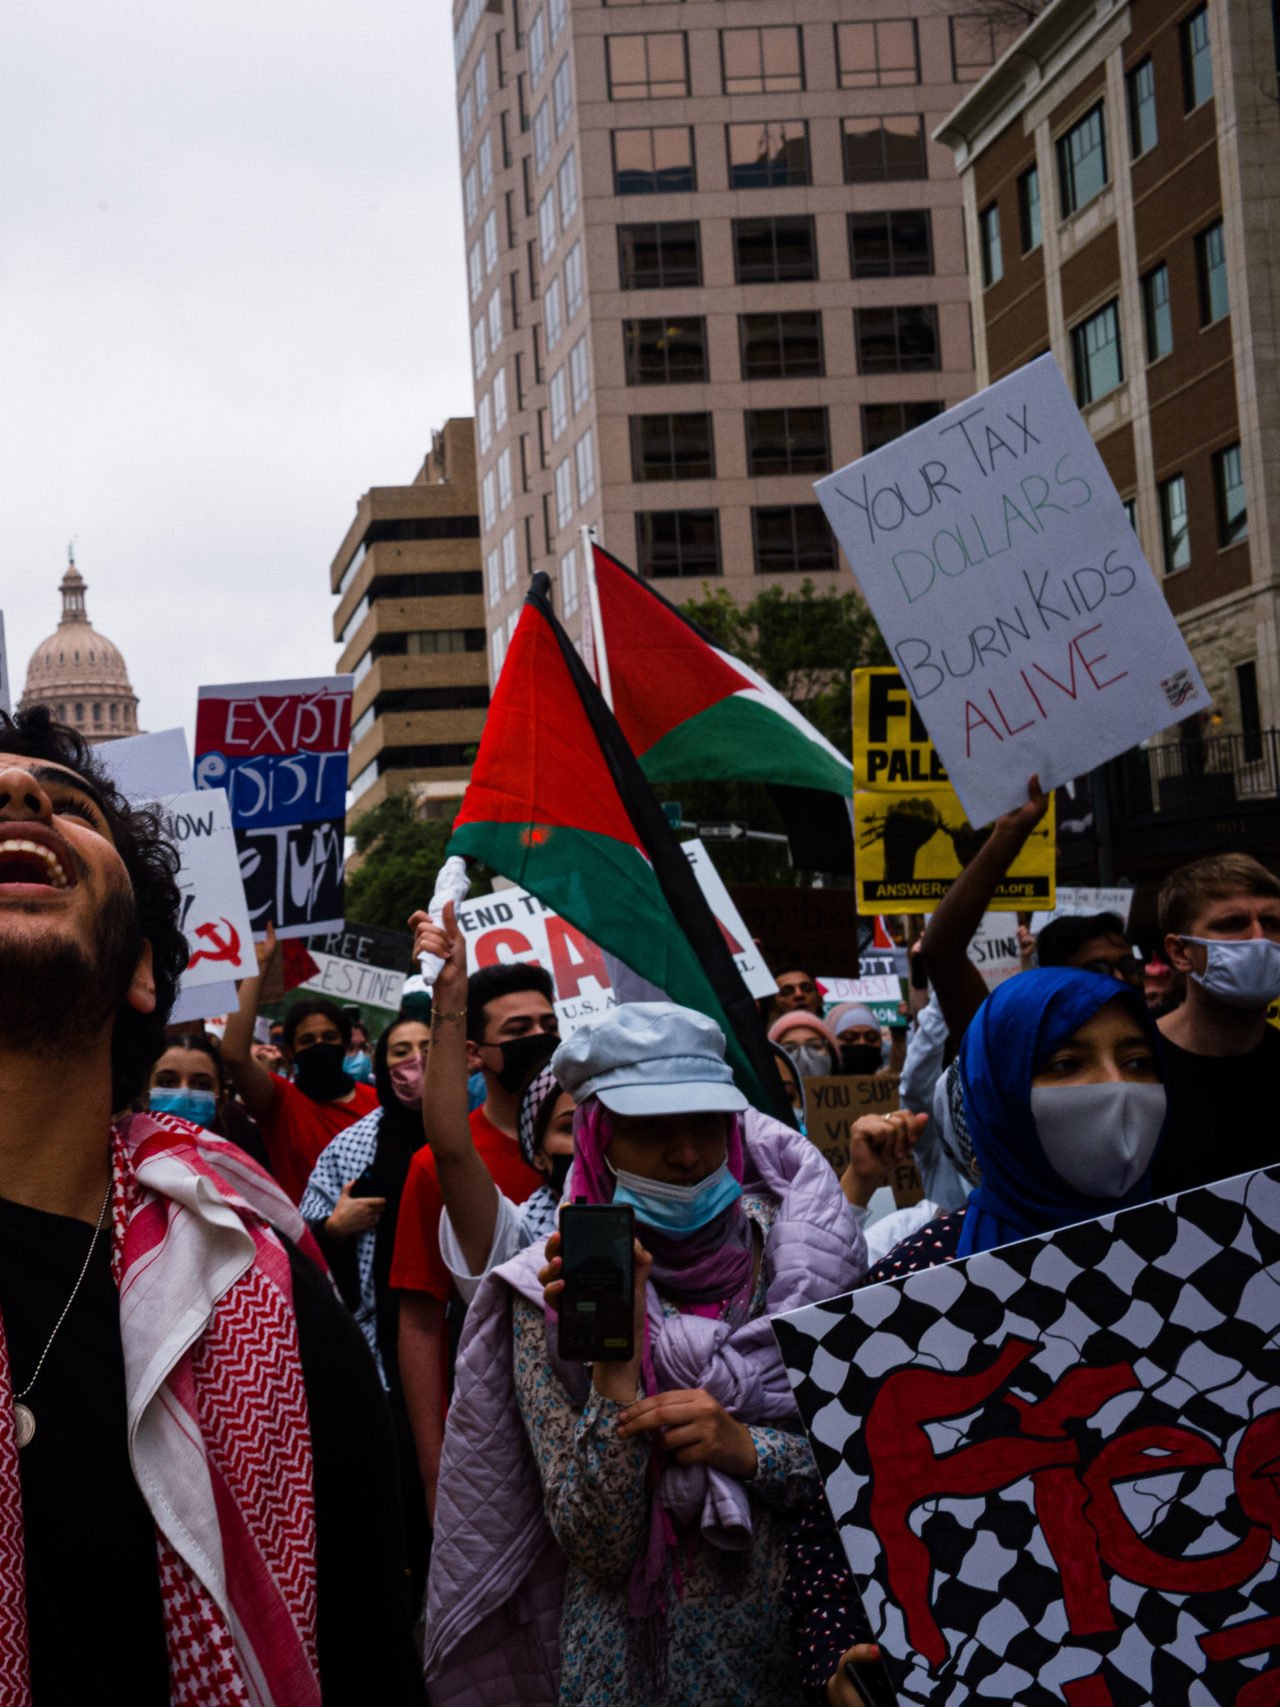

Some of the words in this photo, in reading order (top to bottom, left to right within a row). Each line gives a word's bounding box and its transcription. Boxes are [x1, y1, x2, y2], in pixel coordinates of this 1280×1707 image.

[835, 460, 960, 544] YOUR
[939, 404, 1040, 476] TAX
[892, 453, 1092, 604] DOLLARS
[894, 606, 1031, 699] BURN
[1023, 550, 1136, 631] KIDS
[966, 624, 1129, 758] ALIVE
[867, 750, 948, 782] PALE
[461, 903, 514, 932] END
[307, 959, 401, 1006] ESTINE
[562, 1000, 600, 1019] U.S.
[811, 1085, 850, 1109] YOU
